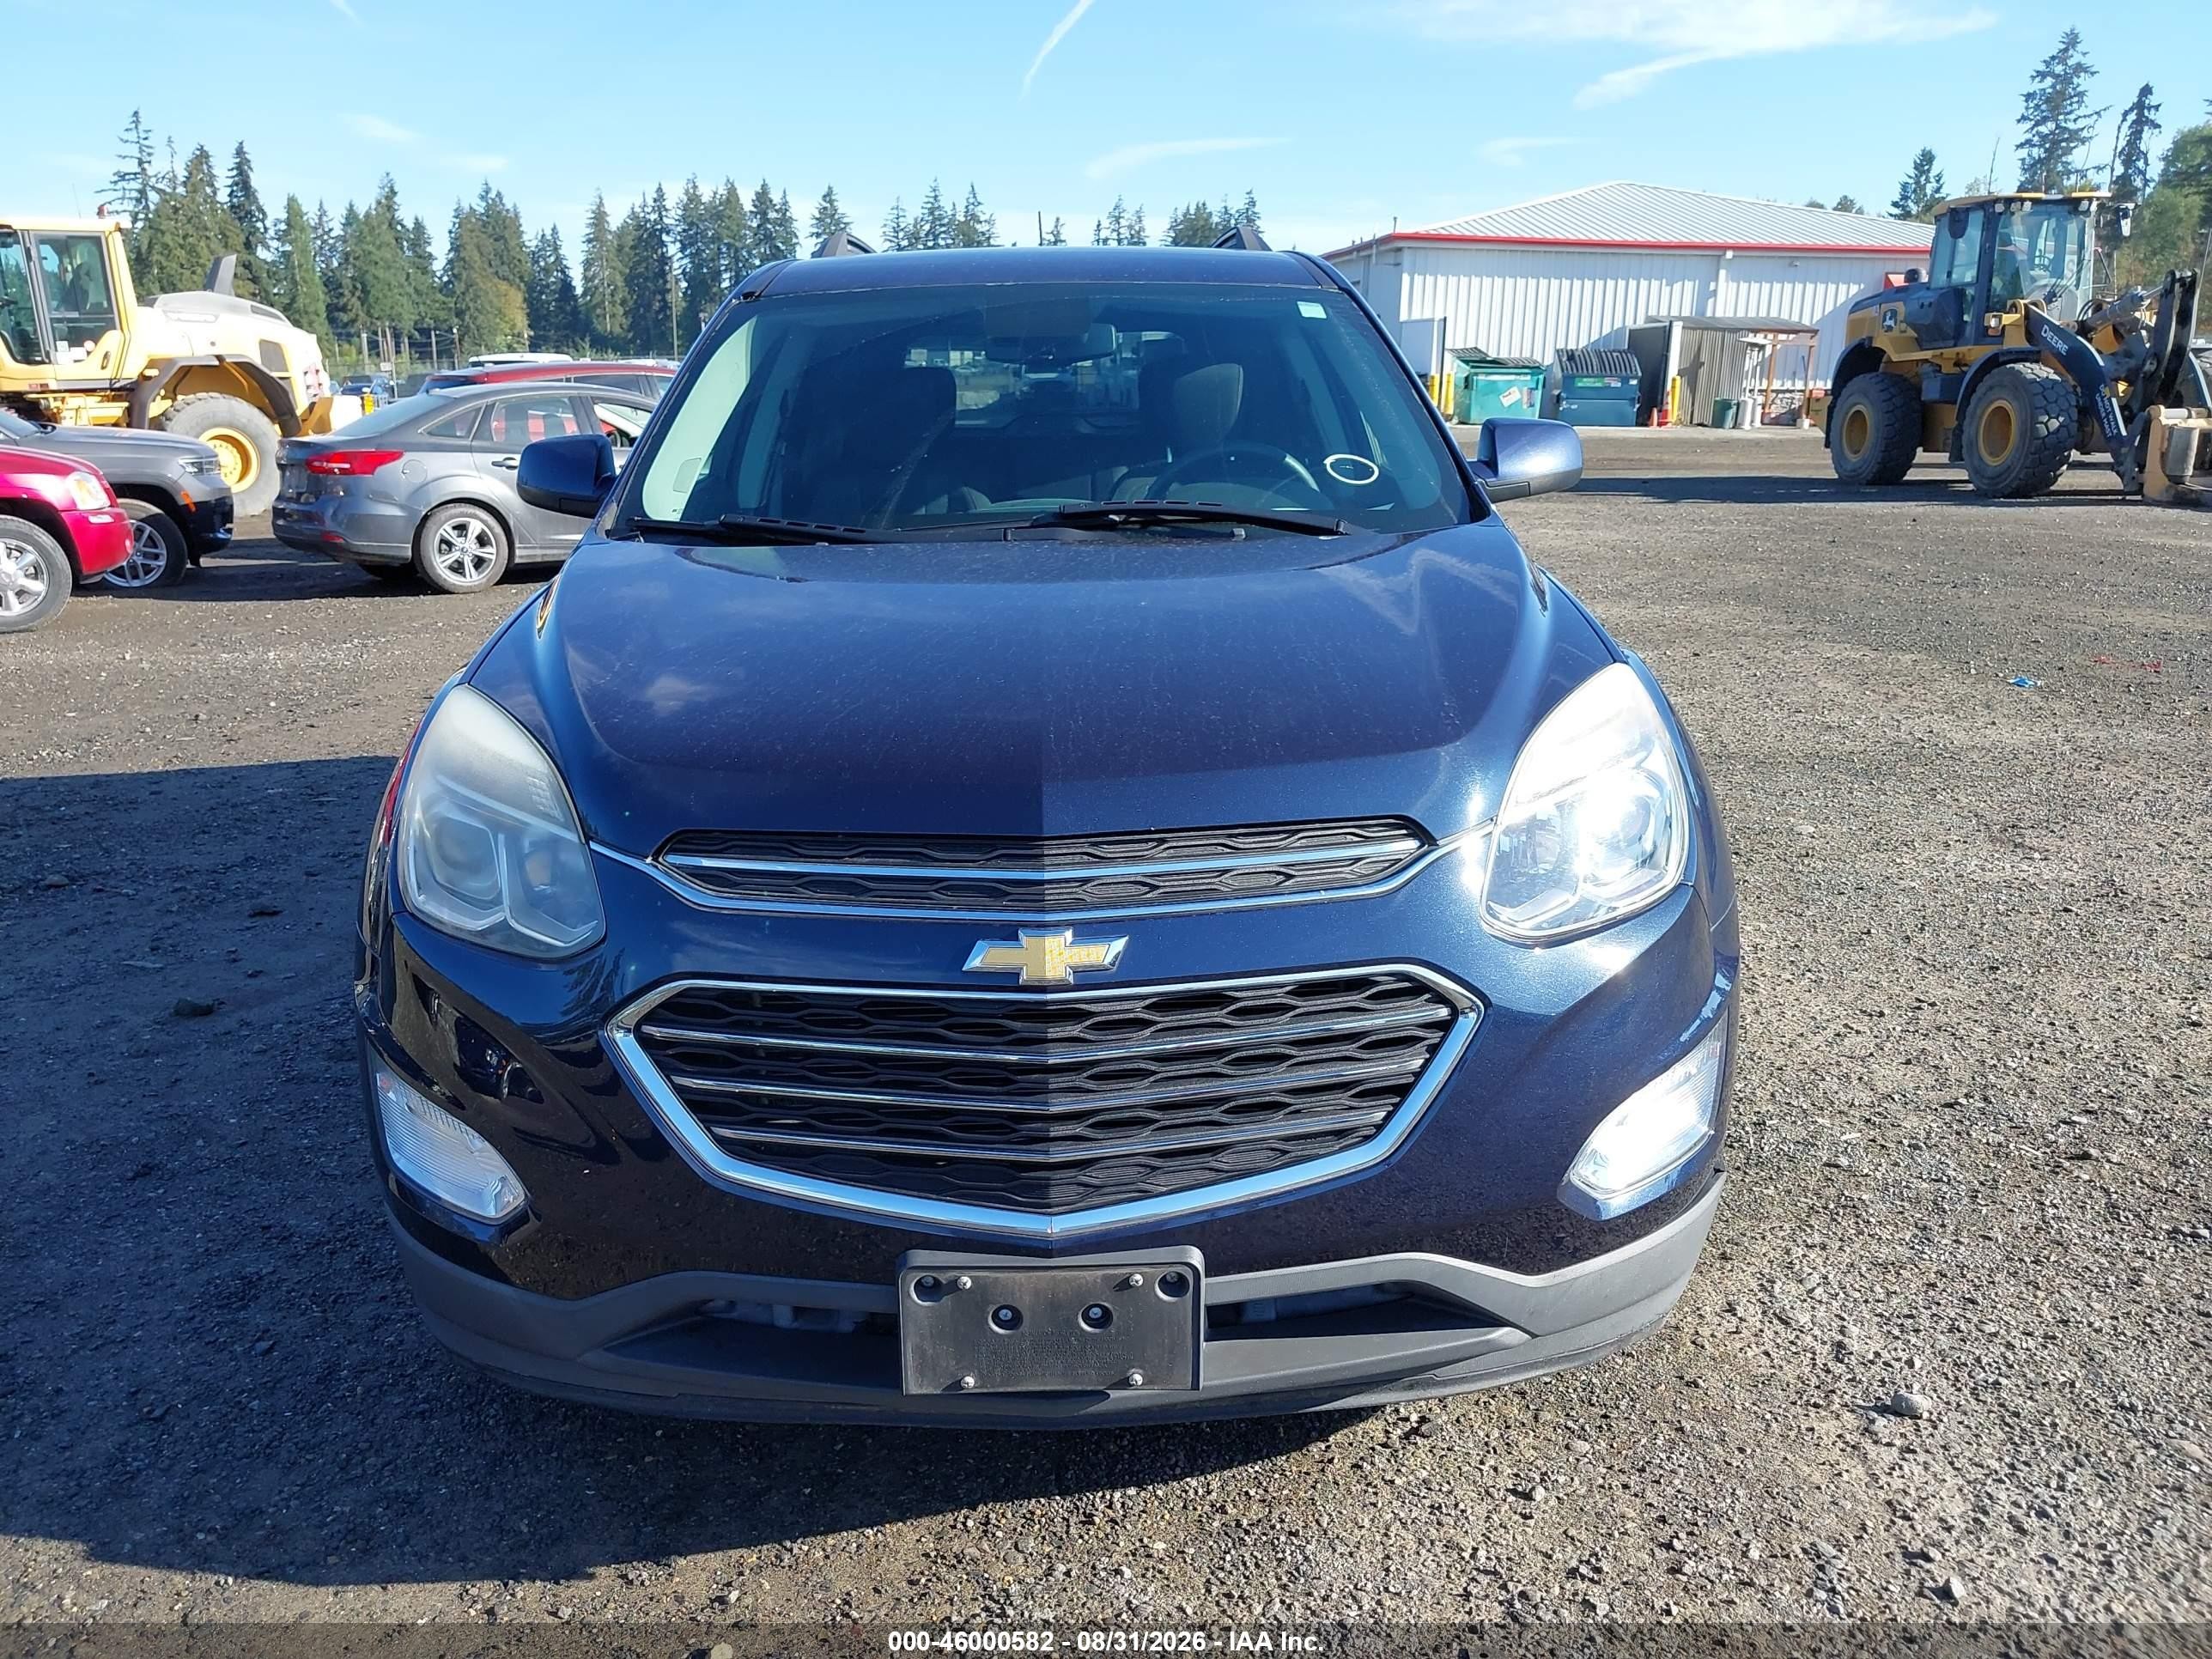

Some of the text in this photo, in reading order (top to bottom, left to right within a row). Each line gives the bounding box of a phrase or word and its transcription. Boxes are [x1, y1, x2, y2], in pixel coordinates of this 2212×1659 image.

[2040, 324, 2069, 356] DEERE
[2095, 392, 2112, 438] UNDER MAST
[2103, 396, 2112, 413] NOT
[2108, 412, 2118, 436] WALK
